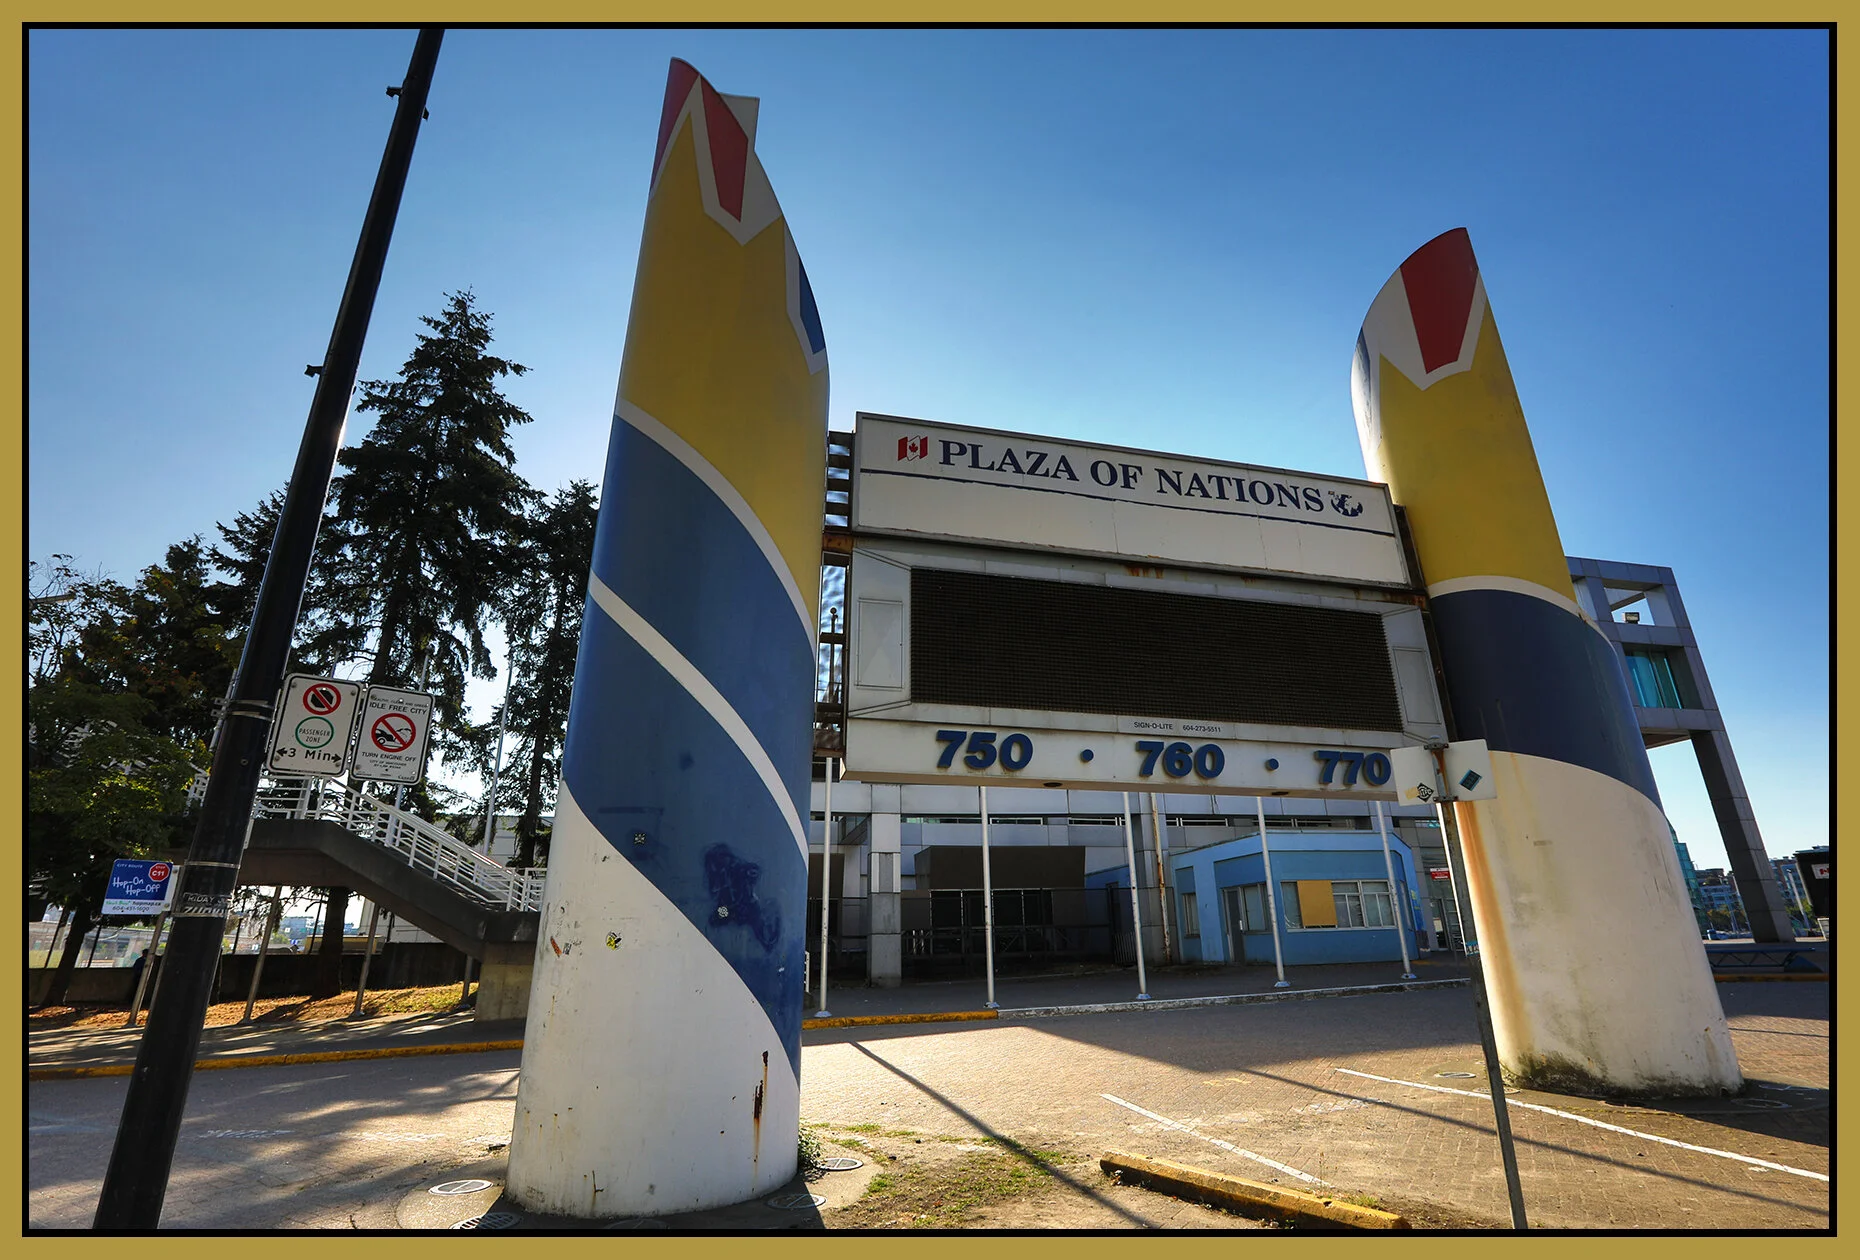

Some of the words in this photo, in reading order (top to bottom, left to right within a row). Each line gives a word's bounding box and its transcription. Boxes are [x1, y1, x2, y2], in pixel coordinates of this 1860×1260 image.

[939, 439, 1079, 482] PLAZA
[1090, 460, 1143, 490] OF
[1154, 468, 1324, 513] NATIONS
[369, 701, 387, 710] IDLE
[388, 704, 408, 713] FREE
[410, 707, 428, 715] CITY
[299, 728, 330, 737] PASSENGER
[1133, 721, 1173, 730] SIGN-O-LITE
[1182, 724, 1221, 733] 604-273-5511
[305, 736, 321, 744] ZONE
[288, 747, 297, 758] 3
[304, 749, 332, 761] Min
[380, 753, 403, 761] ENGINE
[936, 729, 1034, 772] 750
[1135, 740, 1226, 780] 760
[1313, 750, 1392, 787] 770
[112, 876, 144, 889] Hop-On
[125, 883, 161, 897] Hop-Off
